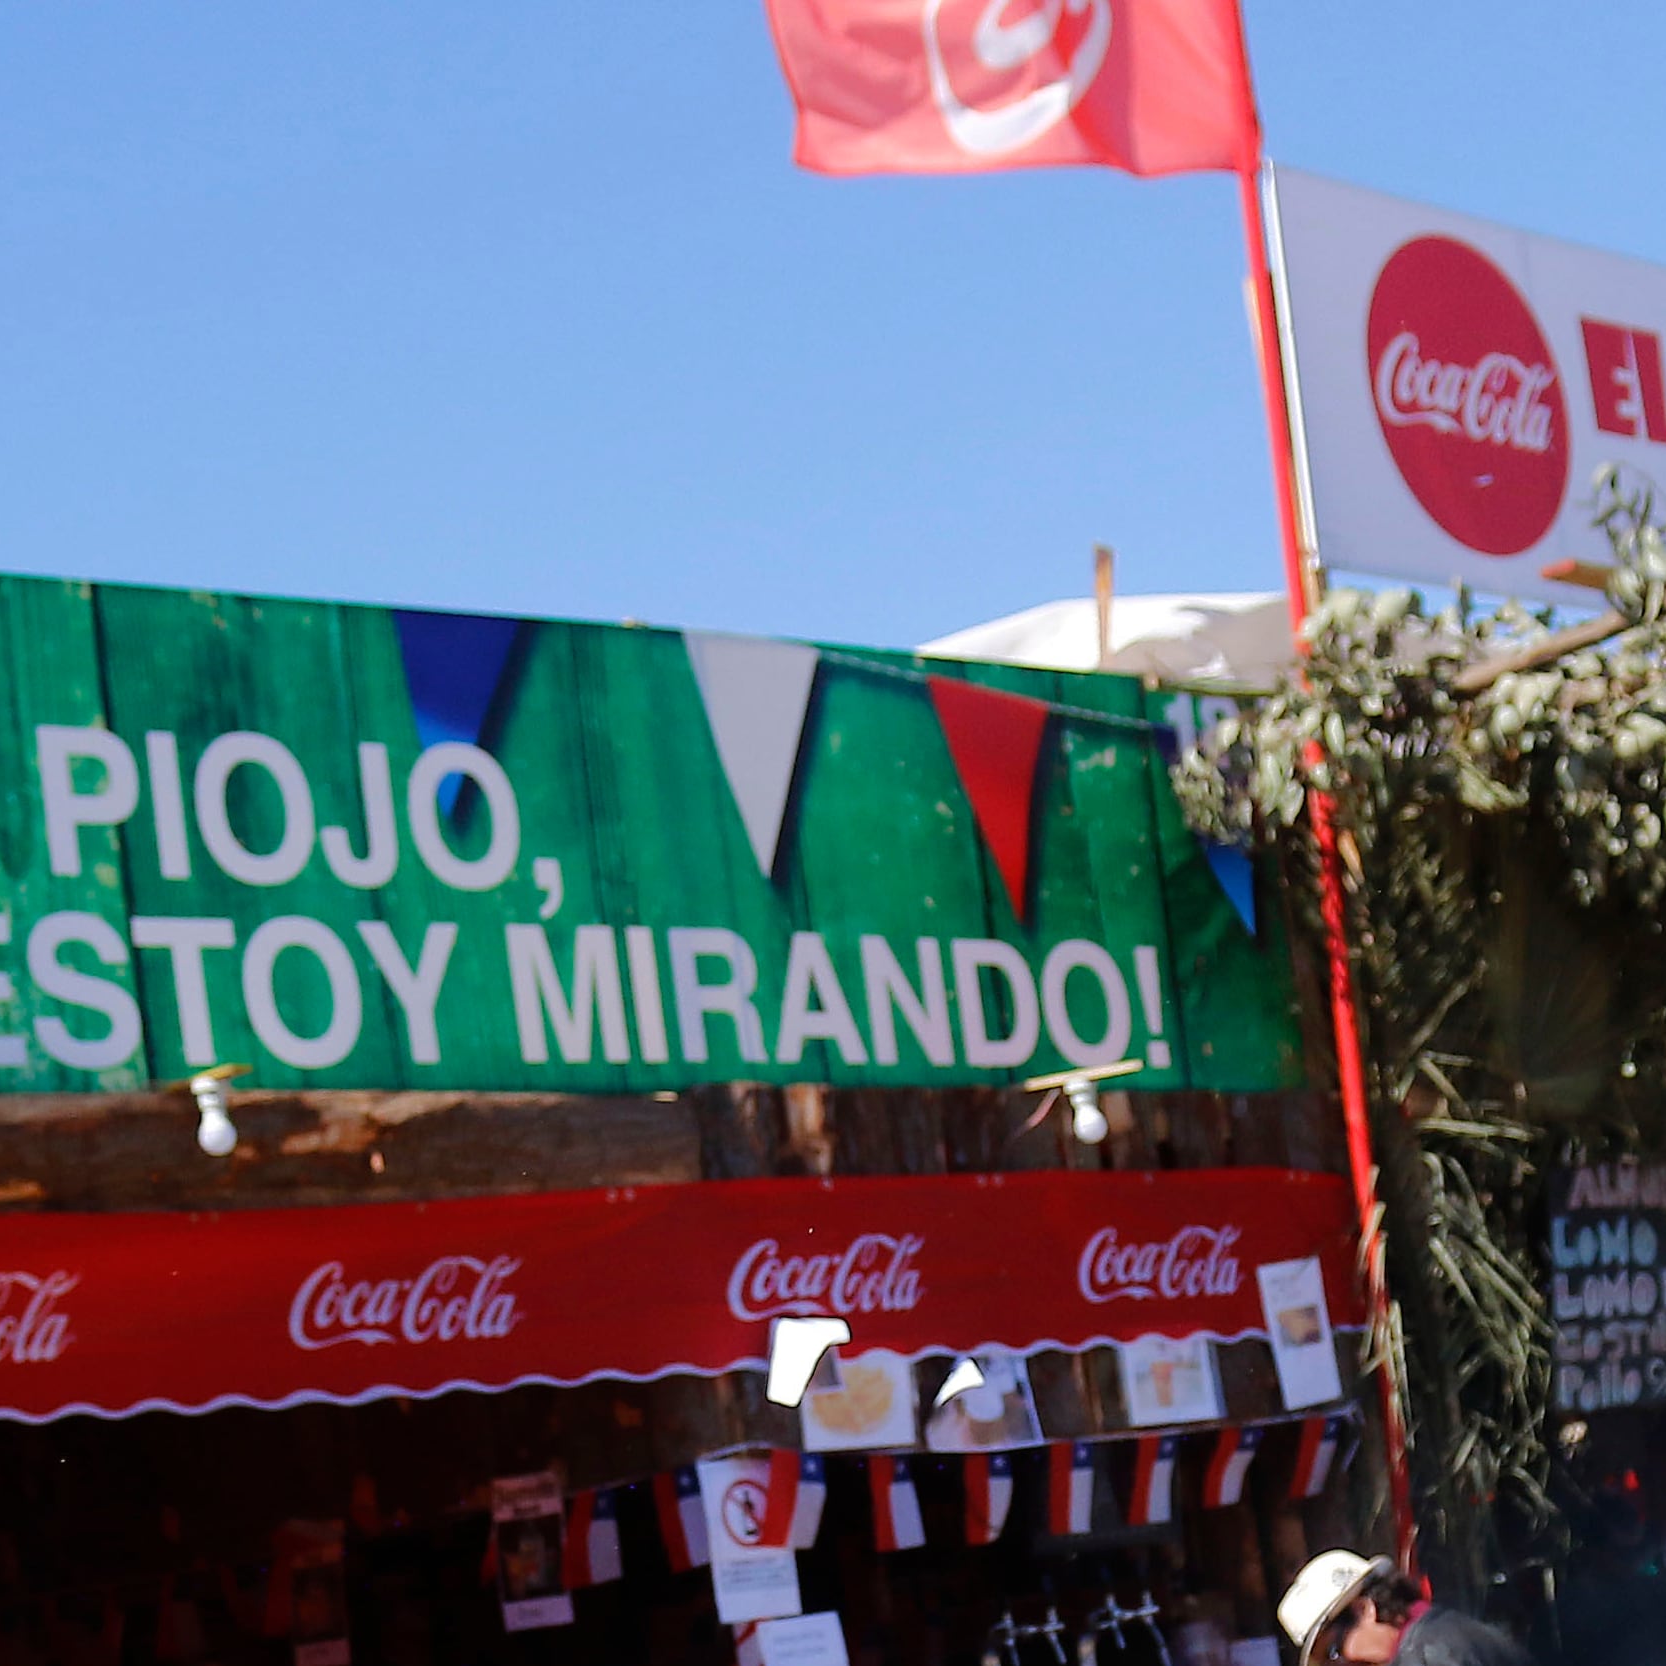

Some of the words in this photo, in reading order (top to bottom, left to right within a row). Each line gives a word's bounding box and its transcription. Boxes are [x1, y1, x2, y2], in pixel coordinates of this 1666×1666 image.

[1377, 331, 1557, 453] Coca-Cola
[36, 724, 564, 919] PIOJO,
[505, 922, 1174, 1069] MIRANDO!
[289, 1254, 524, 1350] Coca-Cola
[728, 1233, 925, 1322] Coca-Cola
[1078, 1224, 1243, 1302] Coca-Cola
